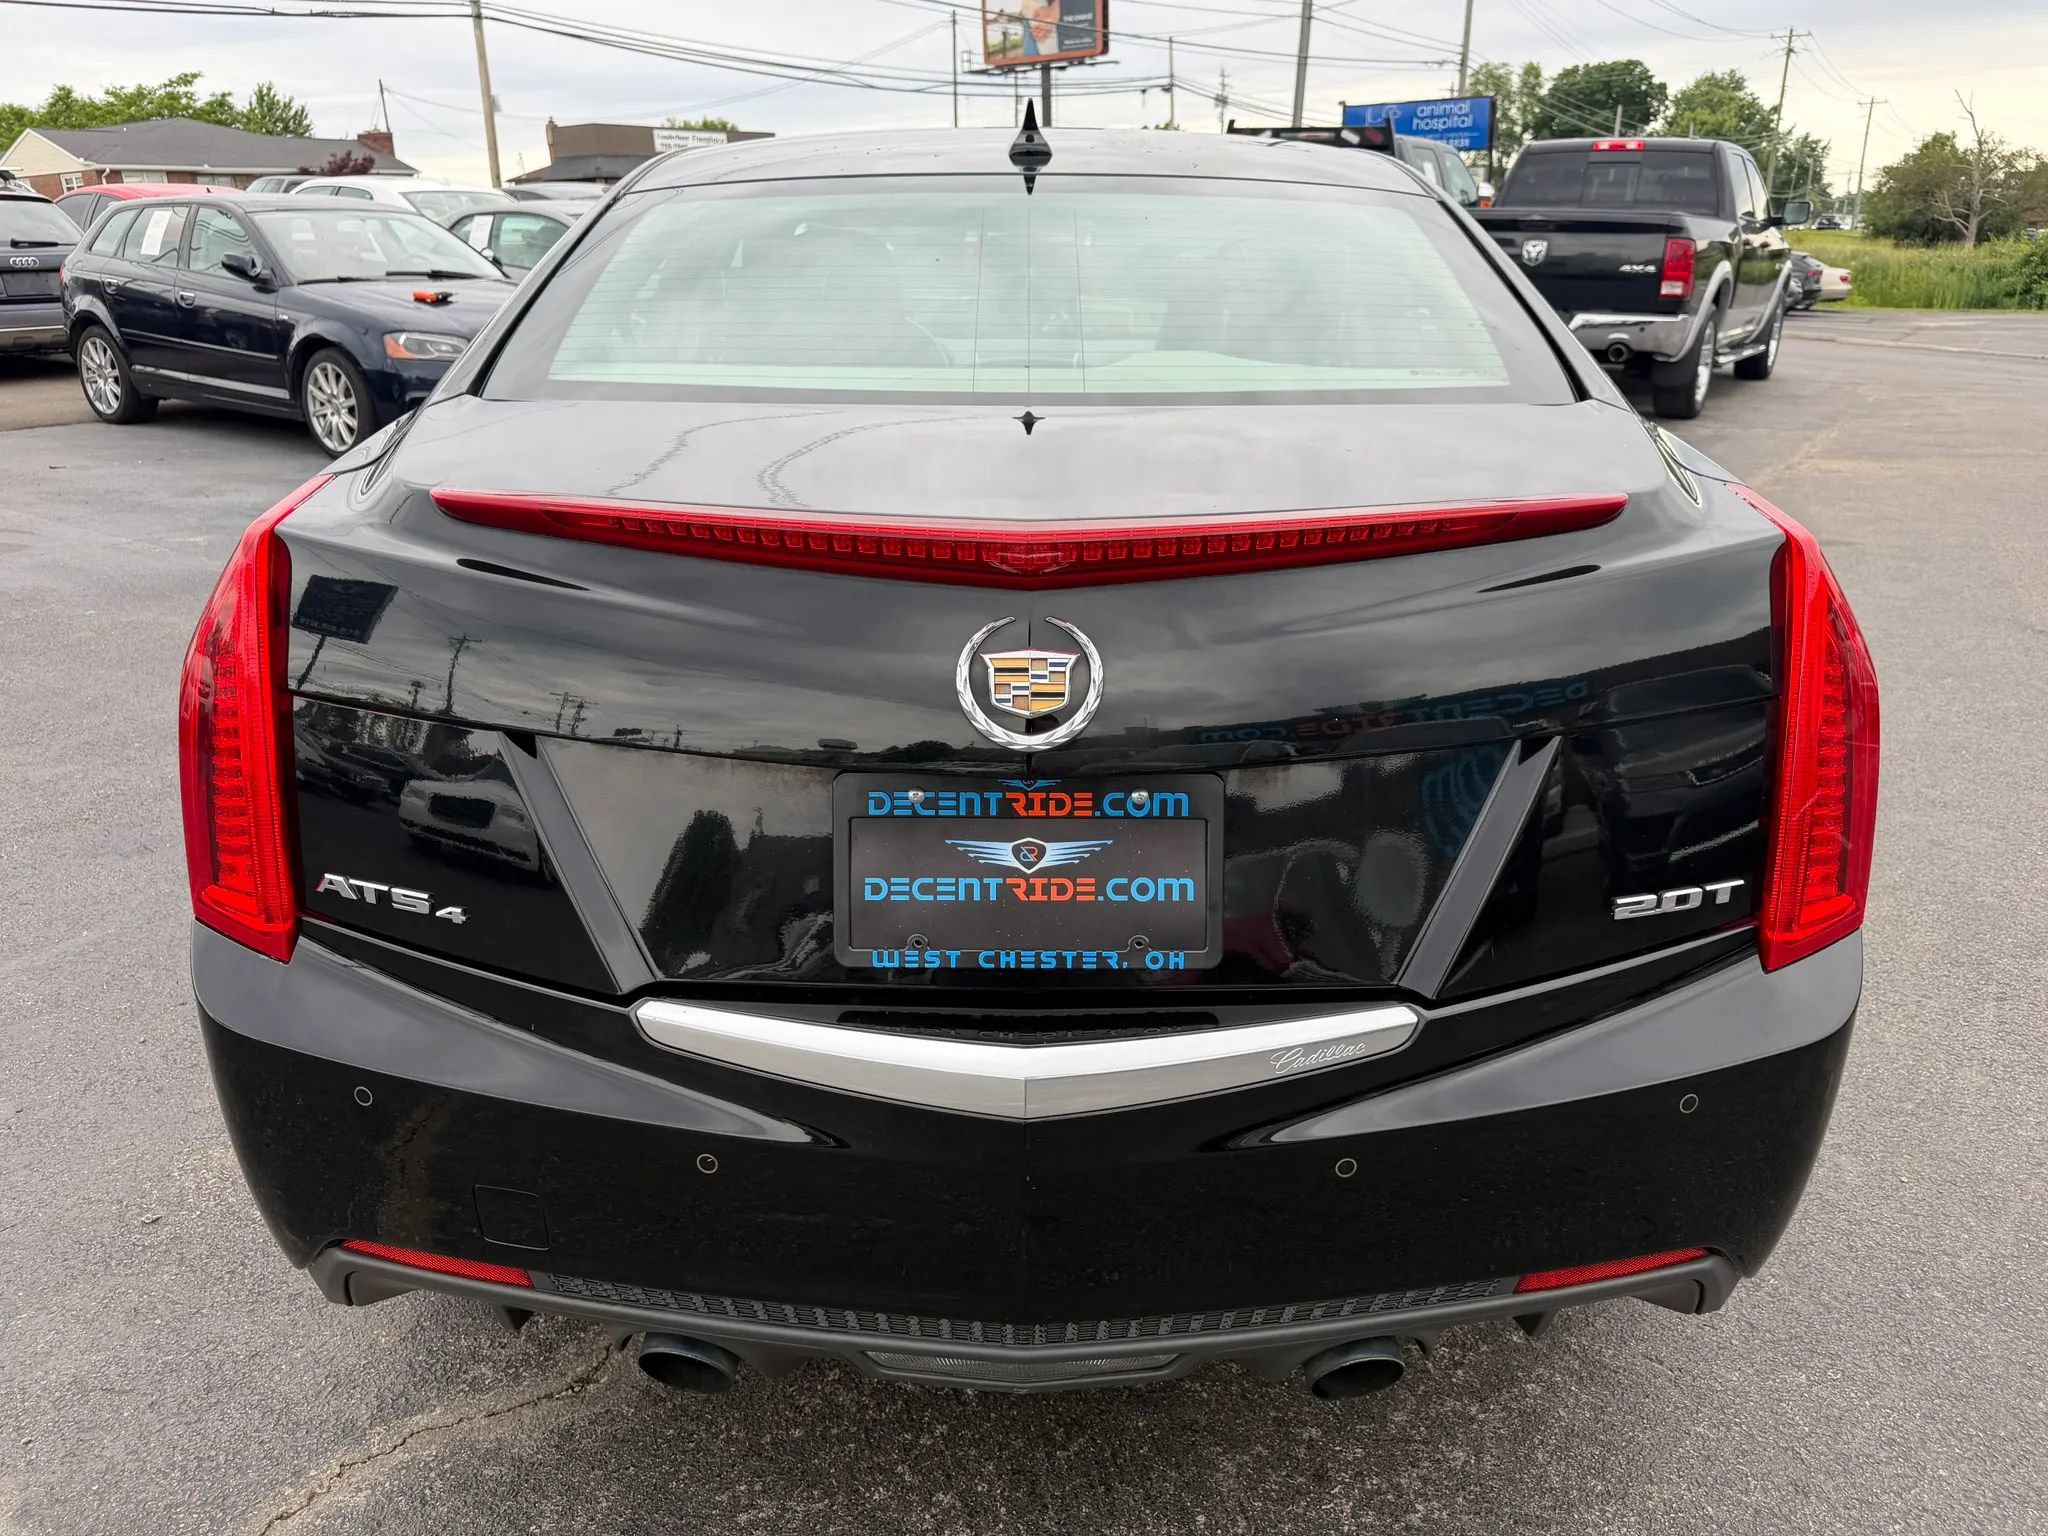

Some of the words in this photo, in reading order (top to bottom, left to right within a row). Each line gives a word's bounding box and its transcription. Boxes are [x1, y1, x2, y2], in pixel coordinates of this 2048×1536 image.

[1416, 100, 1471, 117] animal
[1412, 114, 1473, 131] hospital
[316, 873, 433, 914] ATS
[872, 950, 961, 969] WEST
[978, 950, 1128, 969] CHESTER,
[1145, 950, 1186, 969] OH
[1269, 1042, 1366, 1074] Cadillac
